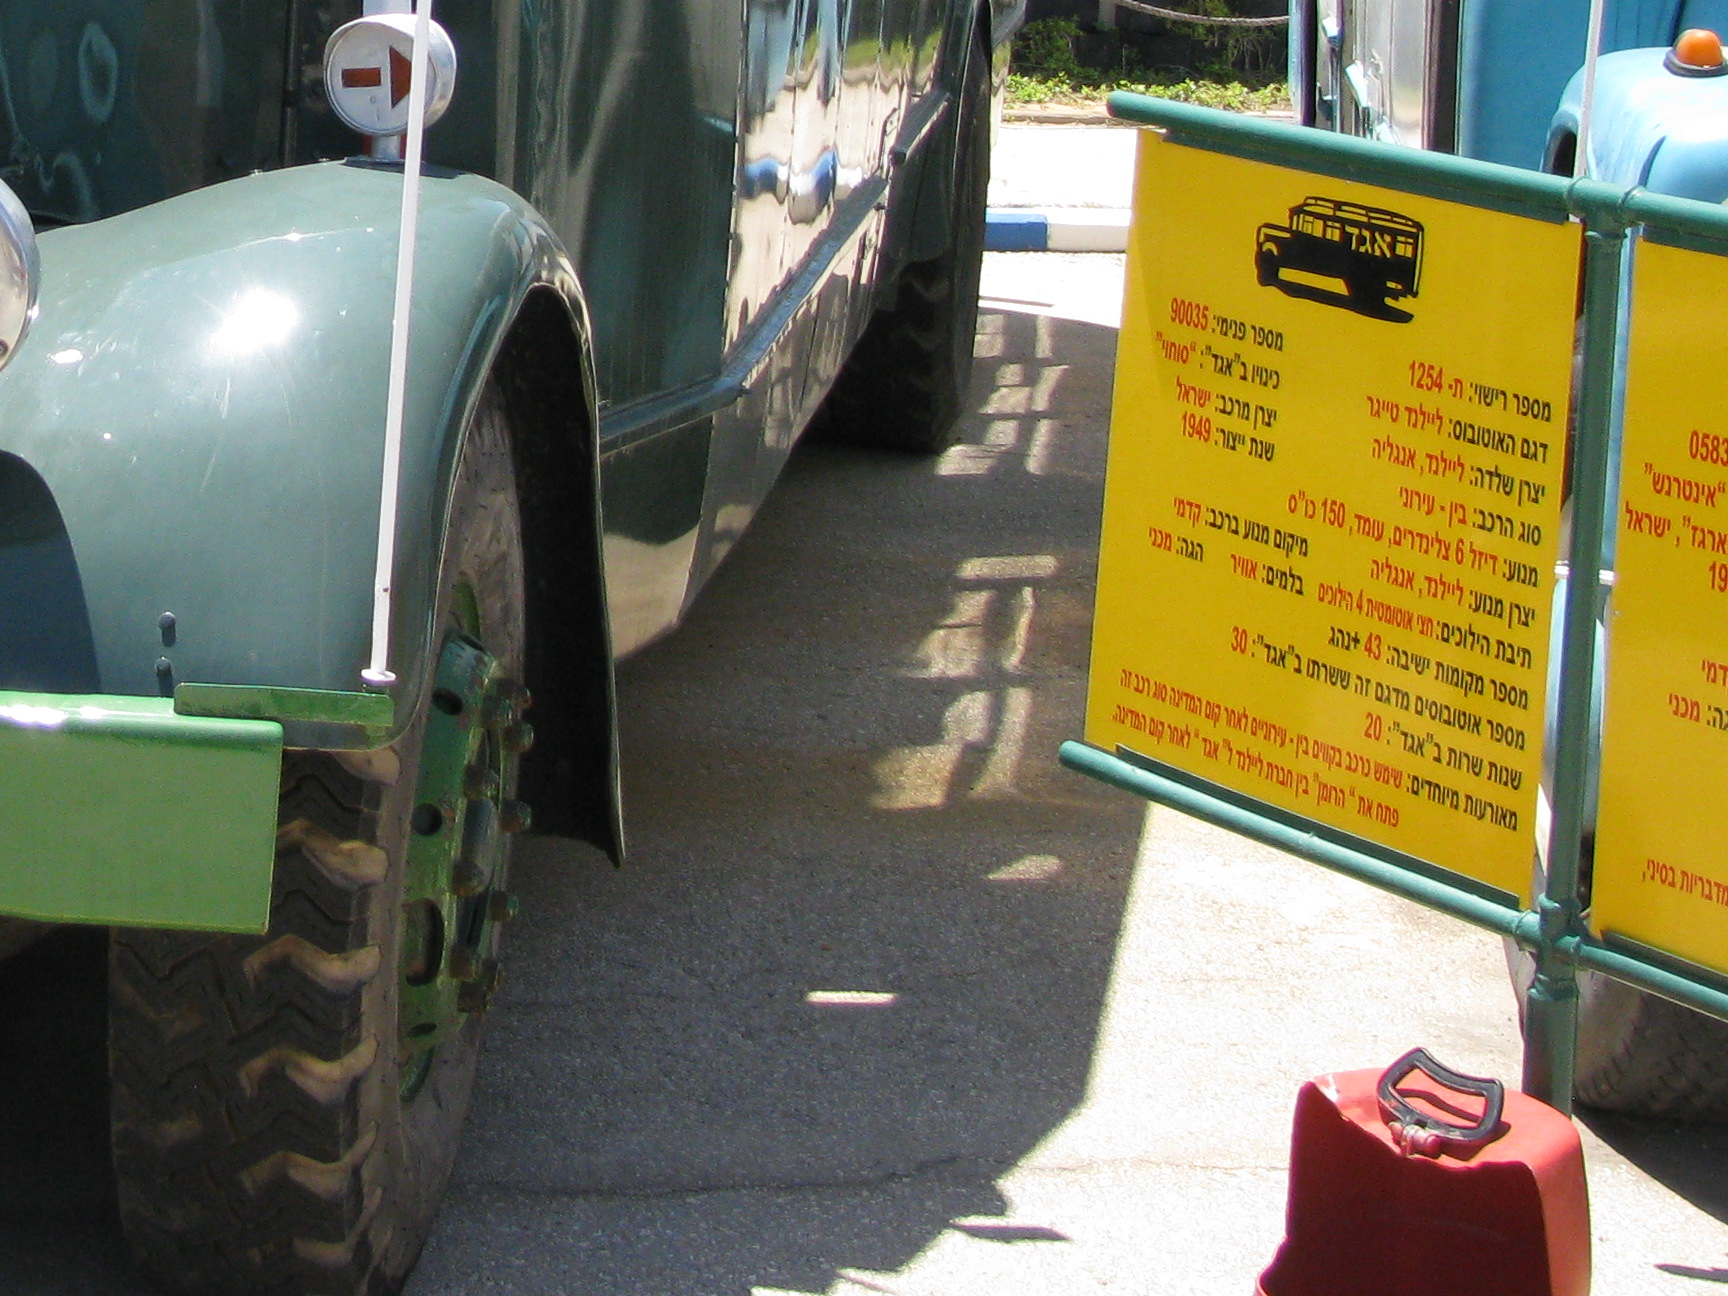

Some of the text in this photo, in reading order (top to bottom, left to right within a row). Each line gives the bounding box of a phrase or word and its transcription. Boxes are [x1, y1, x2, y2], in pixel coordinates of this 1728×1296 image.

[1345, 225, 1391, 258] אגד
[1170, 297, 1284, 351] מספר פנימי: 90035
[1409, 360, 1443, 392] 1254
[1176, 375, 1277, 431] יצרן מרכב: ישראל
[1513, 392, 1551, 422] מספר
[1181, 411, 1275, 462] שנת ייצור: 1949
[1365, 395, 1548, 463] דגם האוטובוס: ליילנד טייגר
[1371, 434, 1416, 469] אנגליה
[1469, 465, 1514, 497] שלדה:
[1516, 479, 1545, 507] יצרן
[1321, 497, 1345, 528] 150
[1399, 486, 1436, 516] עירוני
[1448, 501, 1467, 527] בין
[1174, 497, 1308, 559] מיקום מנוע ברכב: קדמי
[1473, 507, 1514, 538] הרכב:
[1519, 520, 1541, 546] סוג
[1624, 501, 1671, 538] ישראל
[1149, 527, 1204, 562] הגה: מכני
[1455, 538, 1464, 564] 6
[1470, 541, 1498, 576] דיזל
[1370, 557, 1415, 591] אנגליה
[1503, 557, 1538, 588] מנוע:
[1317, 581, 1354, 612] הילוכים
[1356, 590, 1363, 615] 4
[1468, 589, 1504, 619] מנוע:
[1417, 615, 1434, 638] חצי
[1508, 601, 1536, 629] יצרן
[1231, 625, 1248, 655] 30
[1364, 631, 1382, 661] 43
[1494, 638, 1532, 669] תיבת
[1306, 658, 1351, 690] ששרתו
[1386, 643, 1430, 675] ישיבה:
[1354, 674, 1370, 697] זה
[1434, 660, 1485, 698] מקומות
[1490, 679, 1528, 710] מספר
[1375, 681, 1410, 711] מדגם
[1669, 693, 1700, 722] מכני
[1364, 711, 1382, 741] 20
[1414, 695, 1482, 736] אוטובוסים
[1486, 719, 1525, 751] מספר
[1447, 747, 1483, 777] שרות
[1486, 761, 1522, 791] שנות
[1357, 795, 1373, 819] את
[1463, 793, 1518, 832] מאורעות
